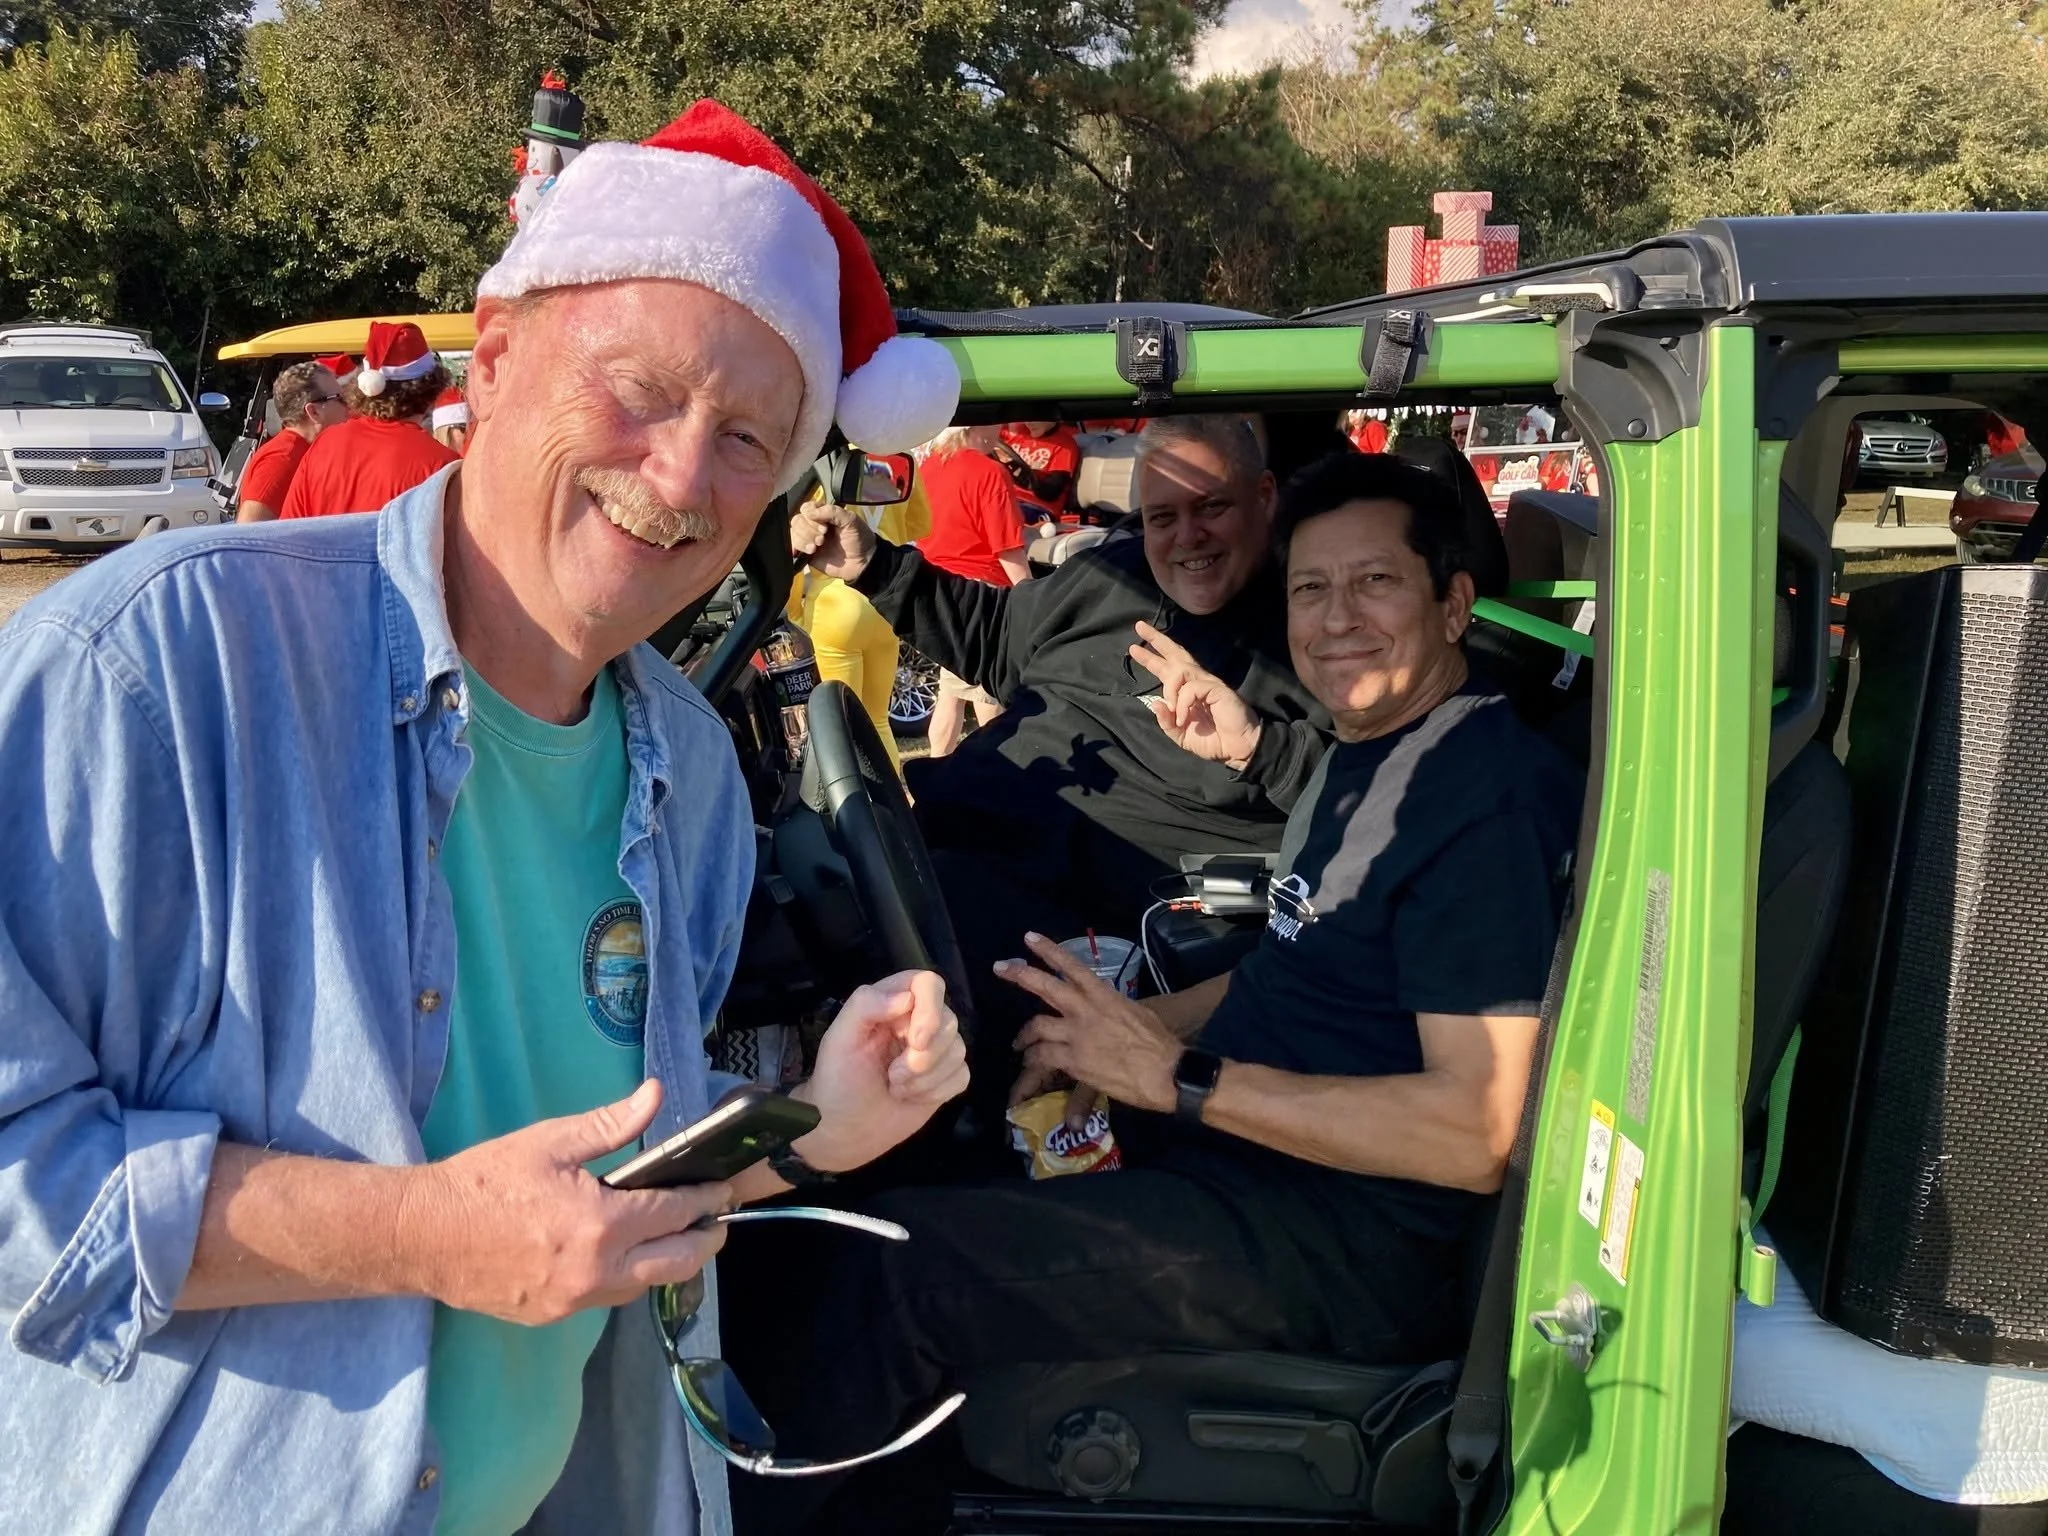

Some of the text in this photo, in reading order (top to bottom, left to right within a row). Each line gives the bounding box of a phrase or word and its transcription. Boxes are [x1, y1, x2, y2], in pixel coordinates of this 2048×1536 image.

[1500, 470, 1520, 481] GOLF
[784, 671, 812, 686] DEER
[787, 679, 813, 694] PARK
[598, 913, 612, 928] NO
[612, 905, 631, 918] TIME
